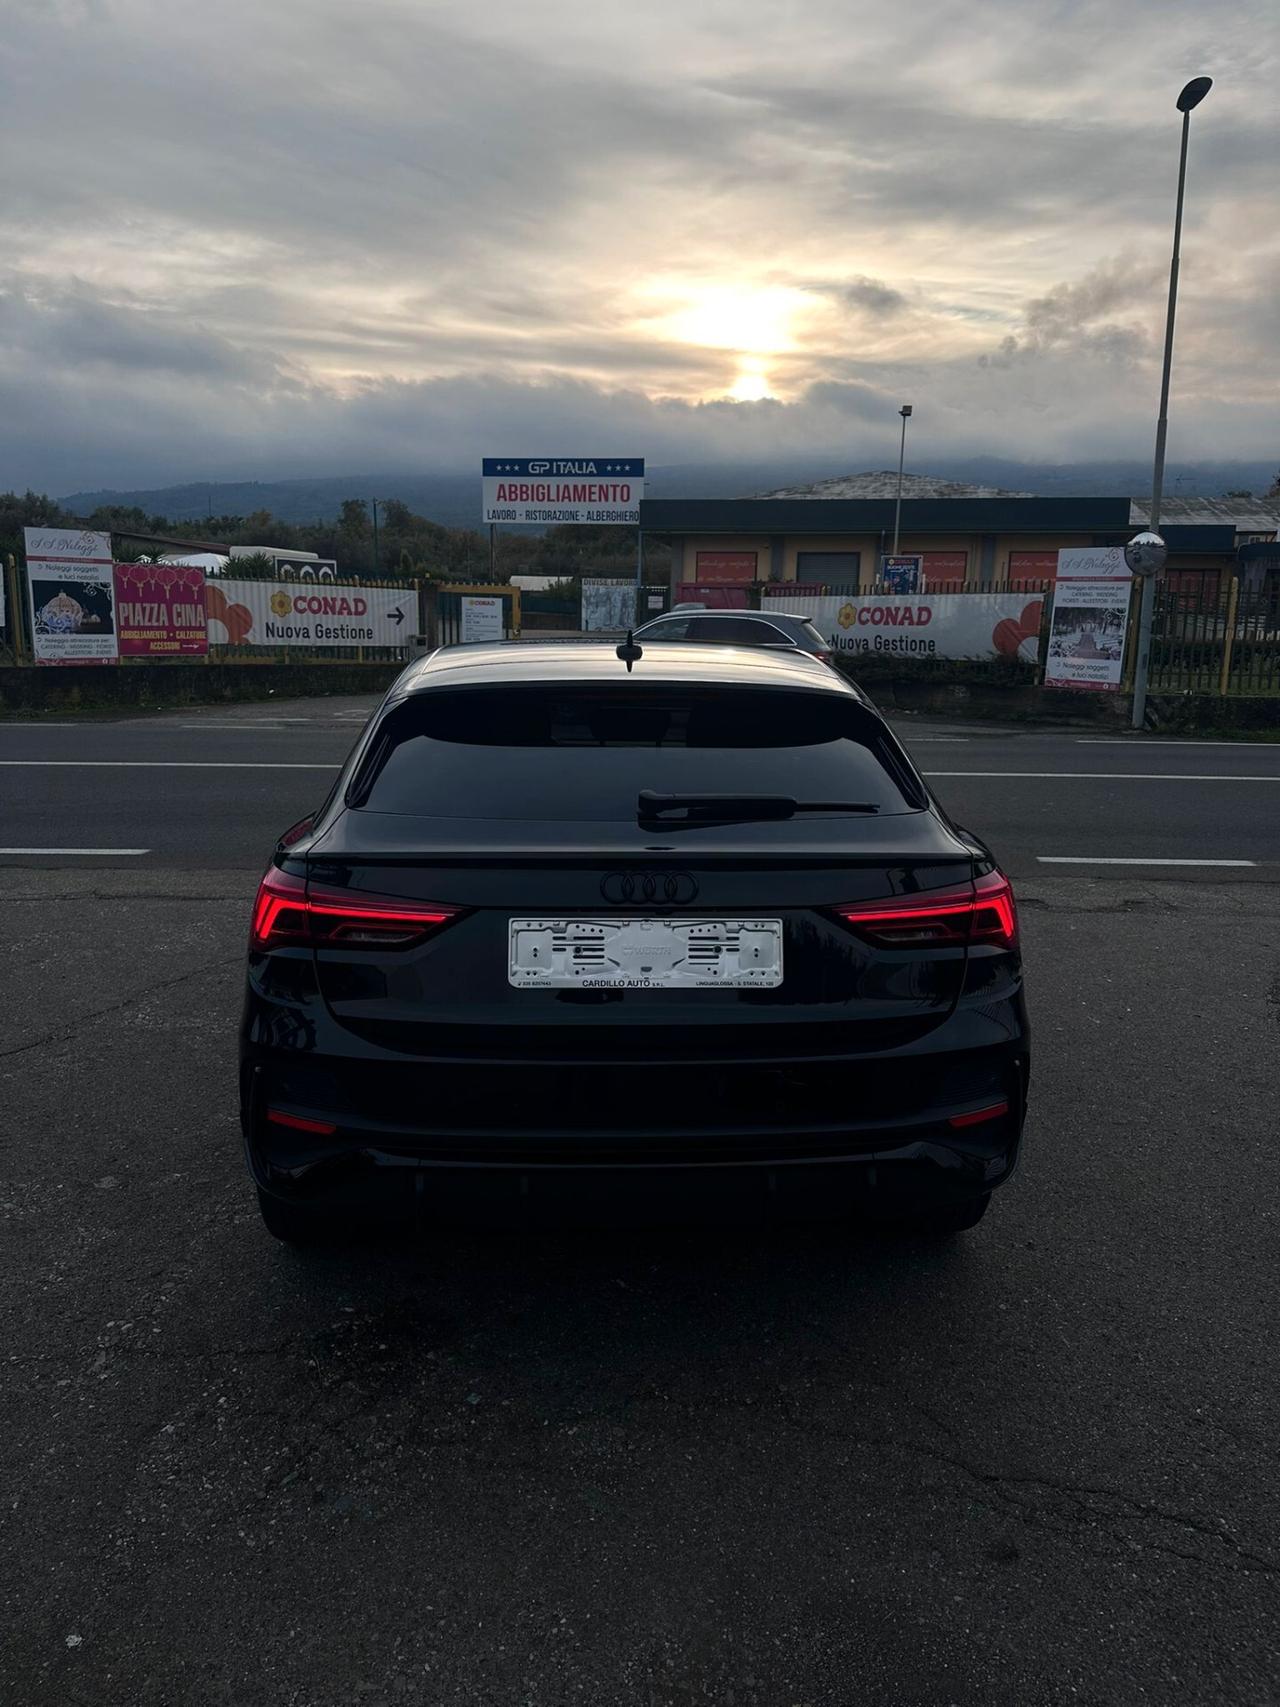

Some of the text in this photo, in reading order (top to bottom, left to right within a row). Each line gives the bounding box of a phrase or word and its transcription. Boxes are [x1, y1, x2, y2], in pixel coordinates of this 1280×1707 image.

[528, 462, 597, 474] GP ITALIA
[496, 484, 631, 503] ABBIGLIAMENTO
[487, 509, 517, 521] LAVORO
[525, 510, 580, 521] RISTORAZIONE
[586, 510, 640, 522] ALBERGHIERO
[118, 602, 206, 627] PIAZZA CINA
[293, 595, 368, 616] CONAD
[857, 606, 932, 626] CONAD
[120, 630, 207, 640] ABBIGLIAMENTO CALZATURE
[265, 622, 374, 640] Nuova Gestione
[831, 634, 936, 652] Nuova Gestione
[582, 979, 625, 987] CARDILLO
[627, 979, 650, 987] AUTO
